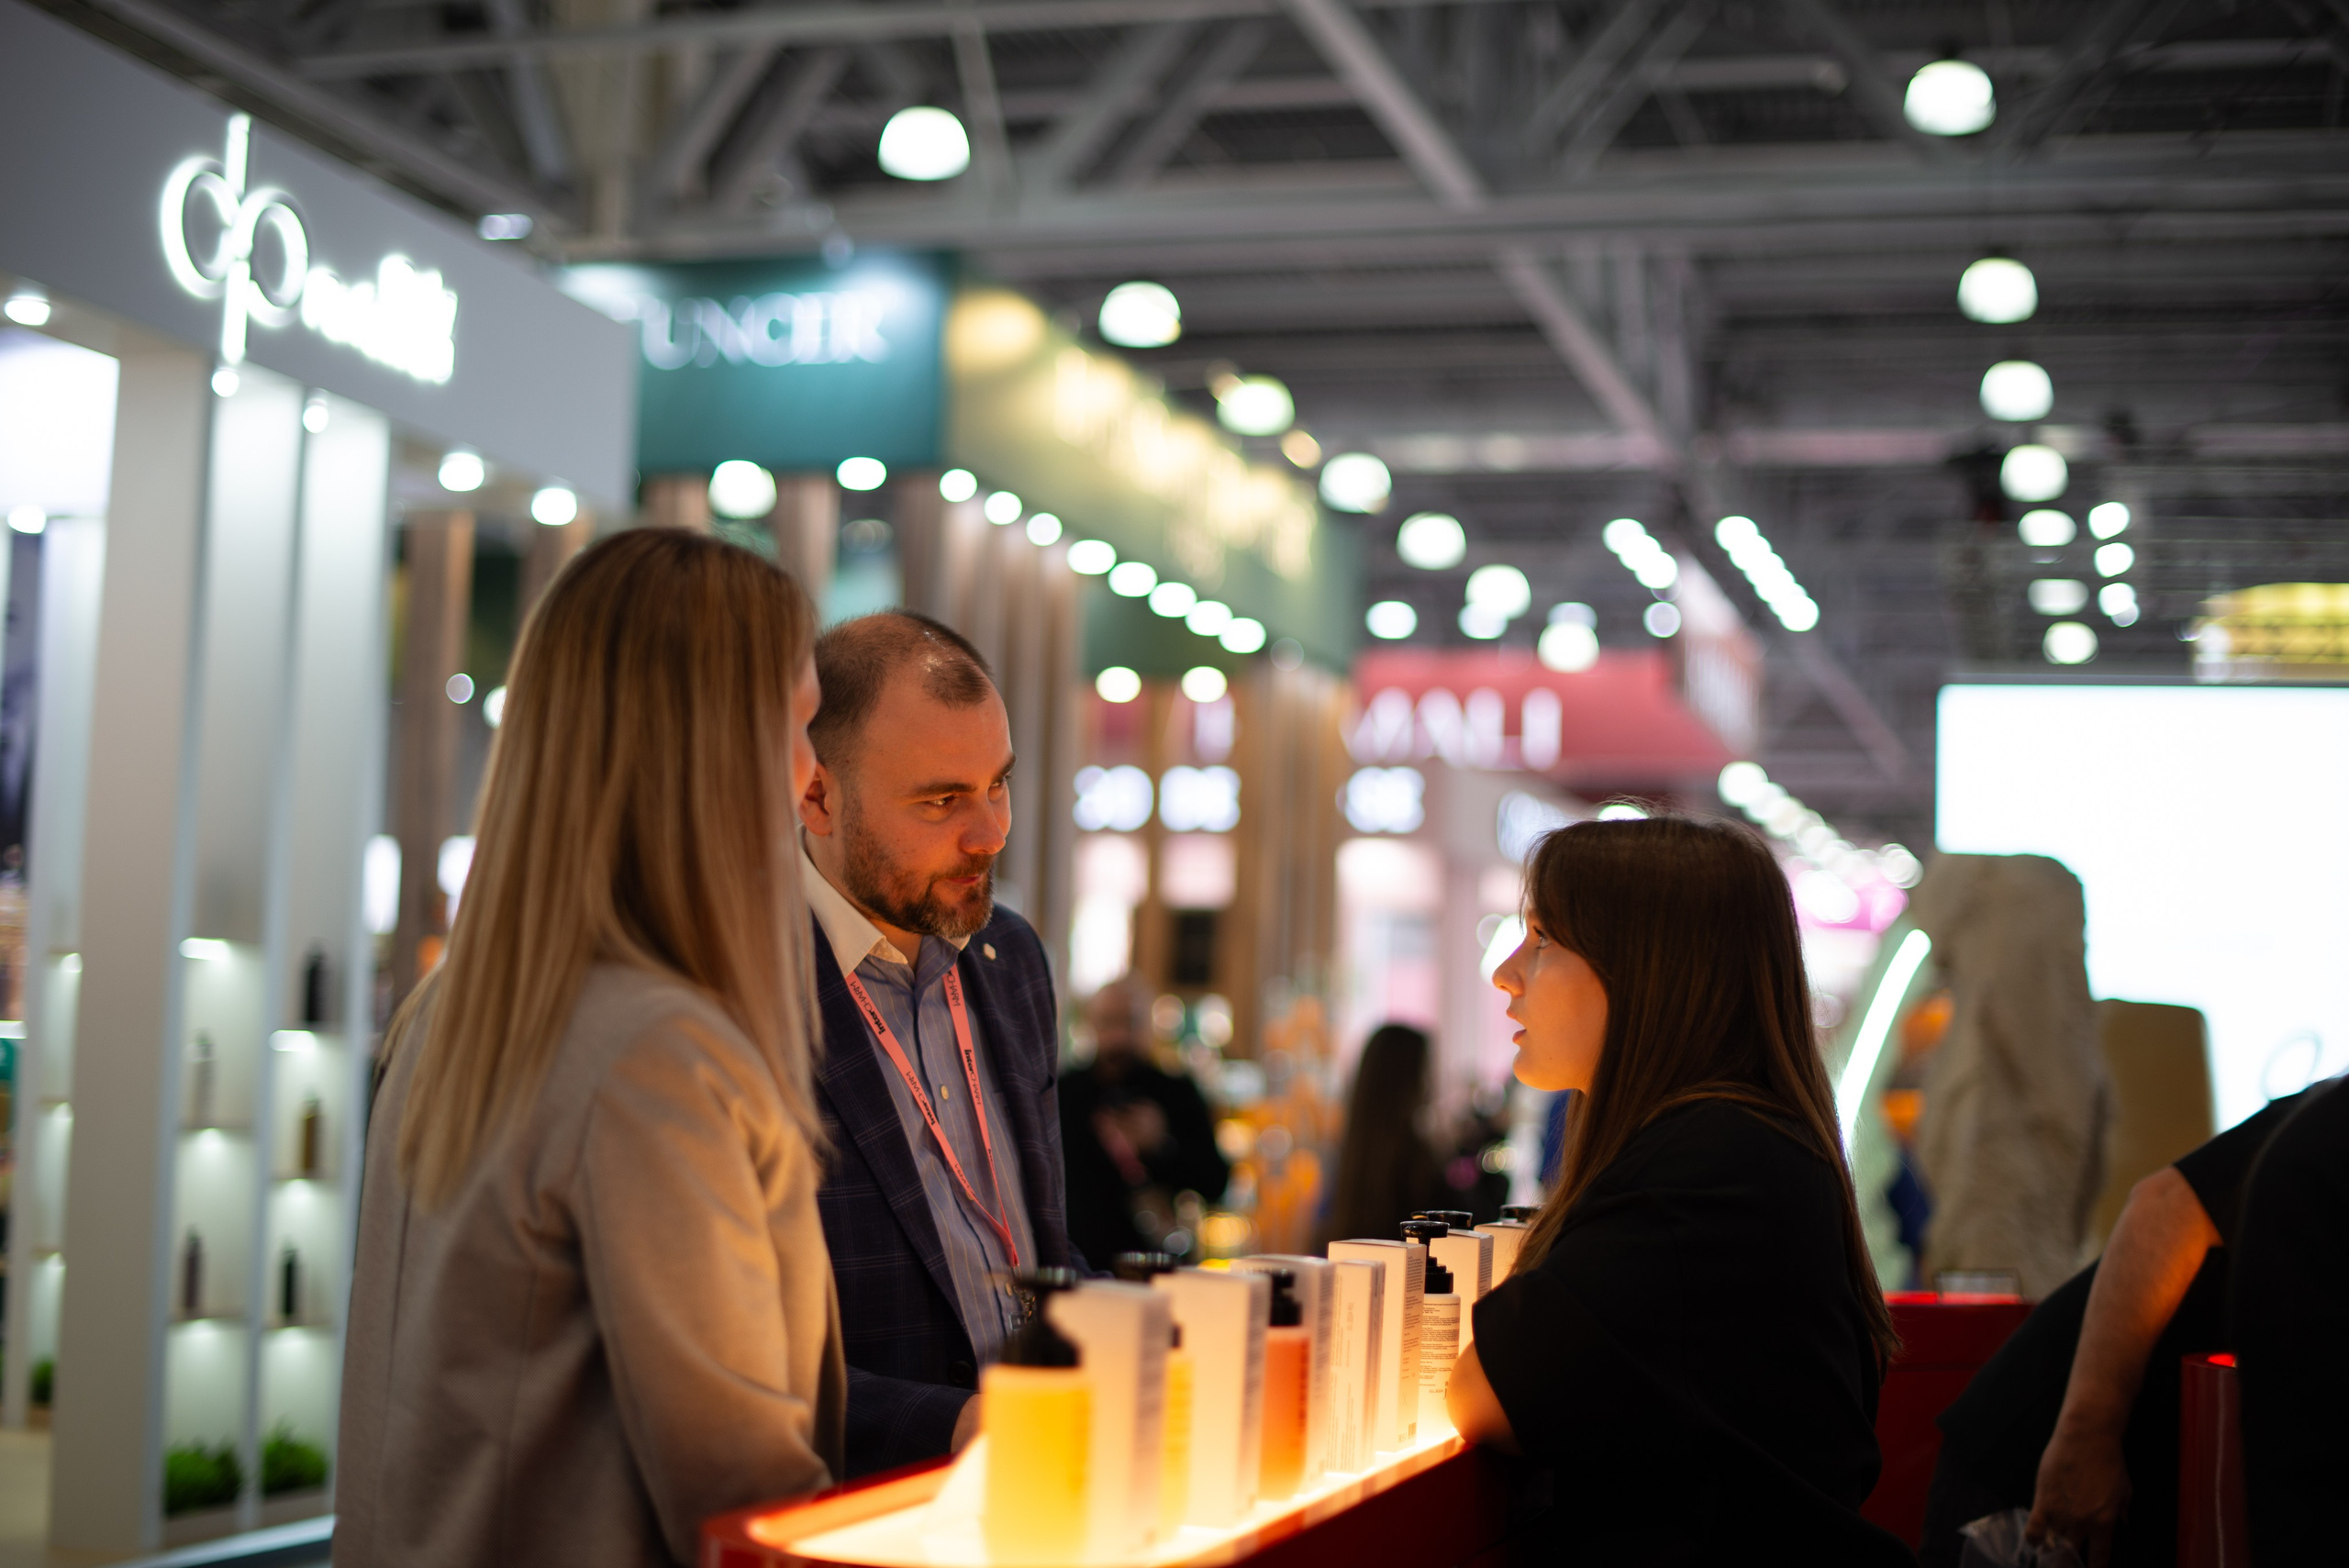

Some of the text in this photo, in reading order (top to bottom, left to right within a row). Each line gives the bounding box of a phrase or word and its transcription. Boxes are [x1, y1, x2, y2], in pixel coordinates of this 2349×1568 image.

[850, 981, 885, 1035] interCHARM
[906, 1071, 936, 1126] interCHARM
[963, 1049, 982, 1105] interCHARM
